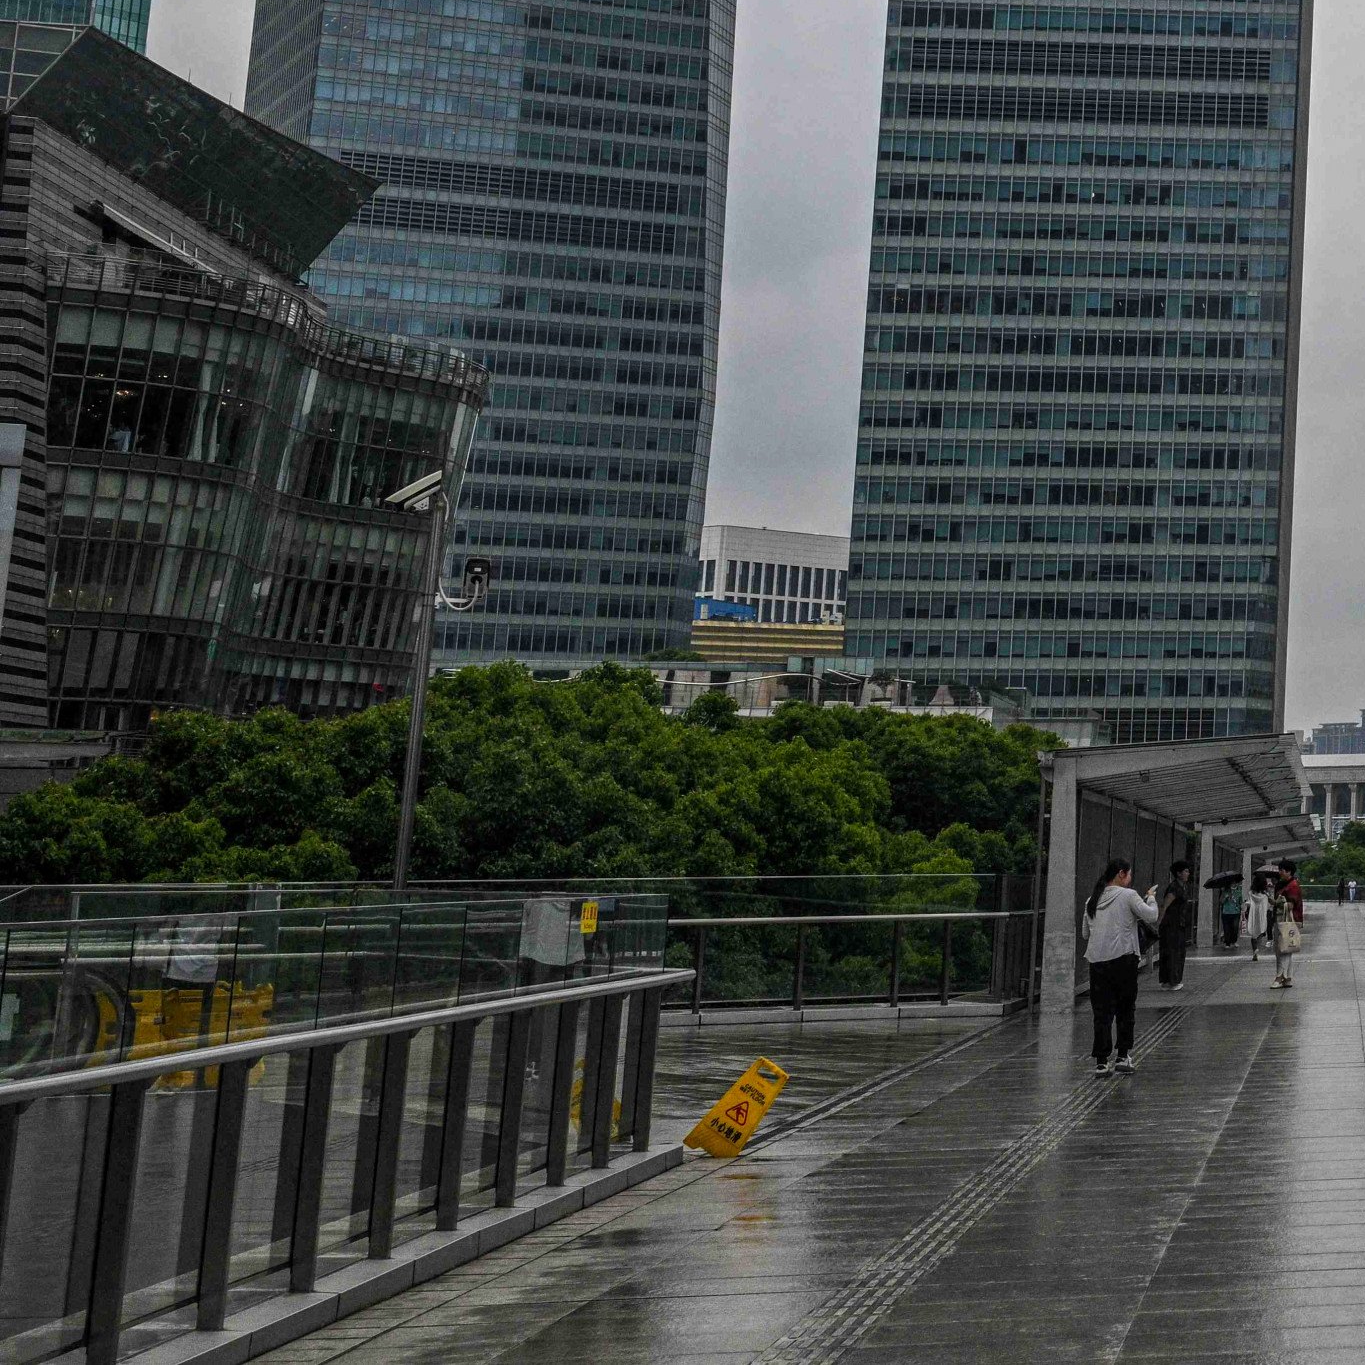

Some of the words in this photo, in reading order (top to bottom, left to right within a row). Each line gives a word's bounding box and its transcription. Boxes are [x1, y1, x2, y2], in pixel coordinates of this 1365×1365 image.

[740, 1086, 750, 1094] WET
[751, 1093, 765, 1106] FLOOR
[745, 1083, 765, 1100] CAUTION
[711, 1117, 742, 1143] 小心地滑
